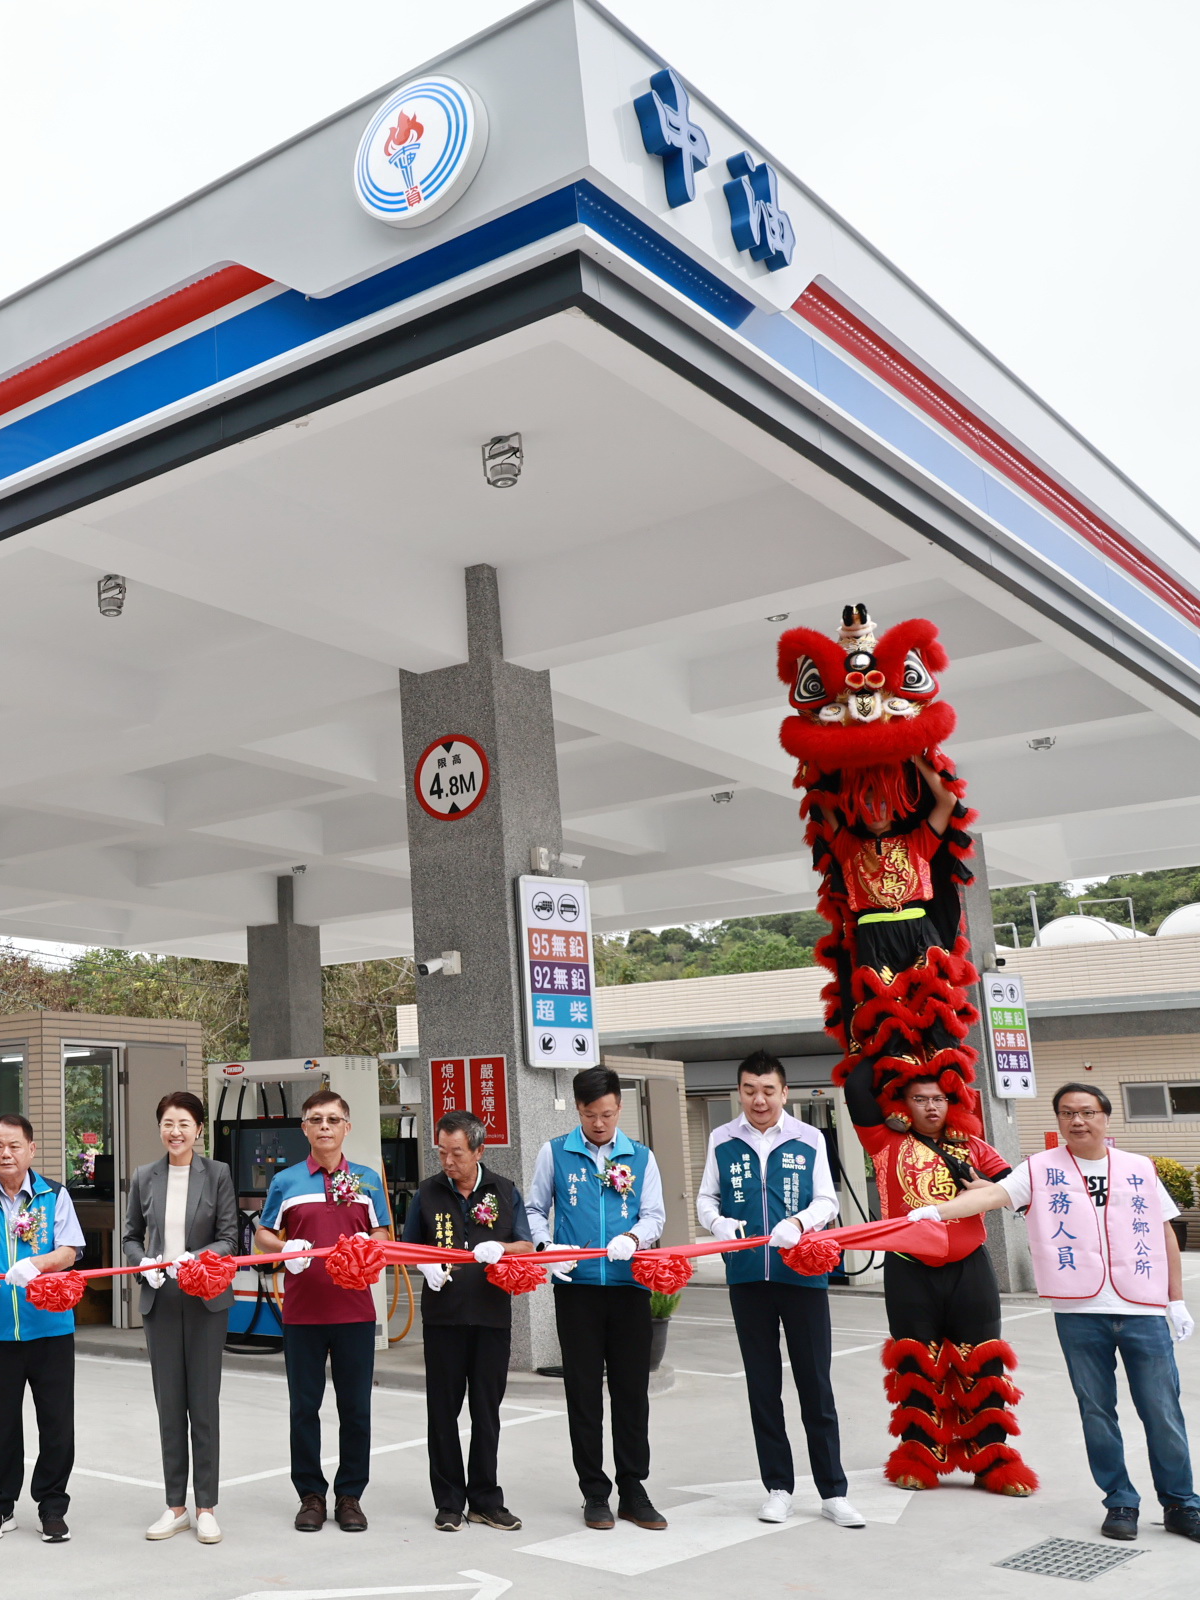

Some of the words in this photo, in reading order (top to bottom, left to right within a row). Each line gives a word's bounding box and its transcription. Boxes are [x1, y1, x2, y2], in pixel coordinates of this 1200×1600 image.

[634, 67, 796, 273] 中油
[437, 753, 462, 769] 限高
[429, 771, 476, 799] 4.8M
[532, 932, 584, 958] 95無鉛
[534, 965, 586, 991] 92無鉛
[536, 999, 588, 1023] 超柴
[992, 1010, 1023, 1026] 98無鉛
[995, 1031, 1026, 1047] 95無鉛
[998, 1053, 1029, 1069] 92無鉛
[441, 1063, 455, 1114] 熄火加
[480, 1064, 496, 1128] 嚴禁煙火
[742, 1153, 752, 1179] 總會長
[730, 1162, 745, 1203] 林哲生
[1046, 1167, 1077, 1272] 服務人員
[1126, 1173, 1153, 1281] 中寮鄉公所
